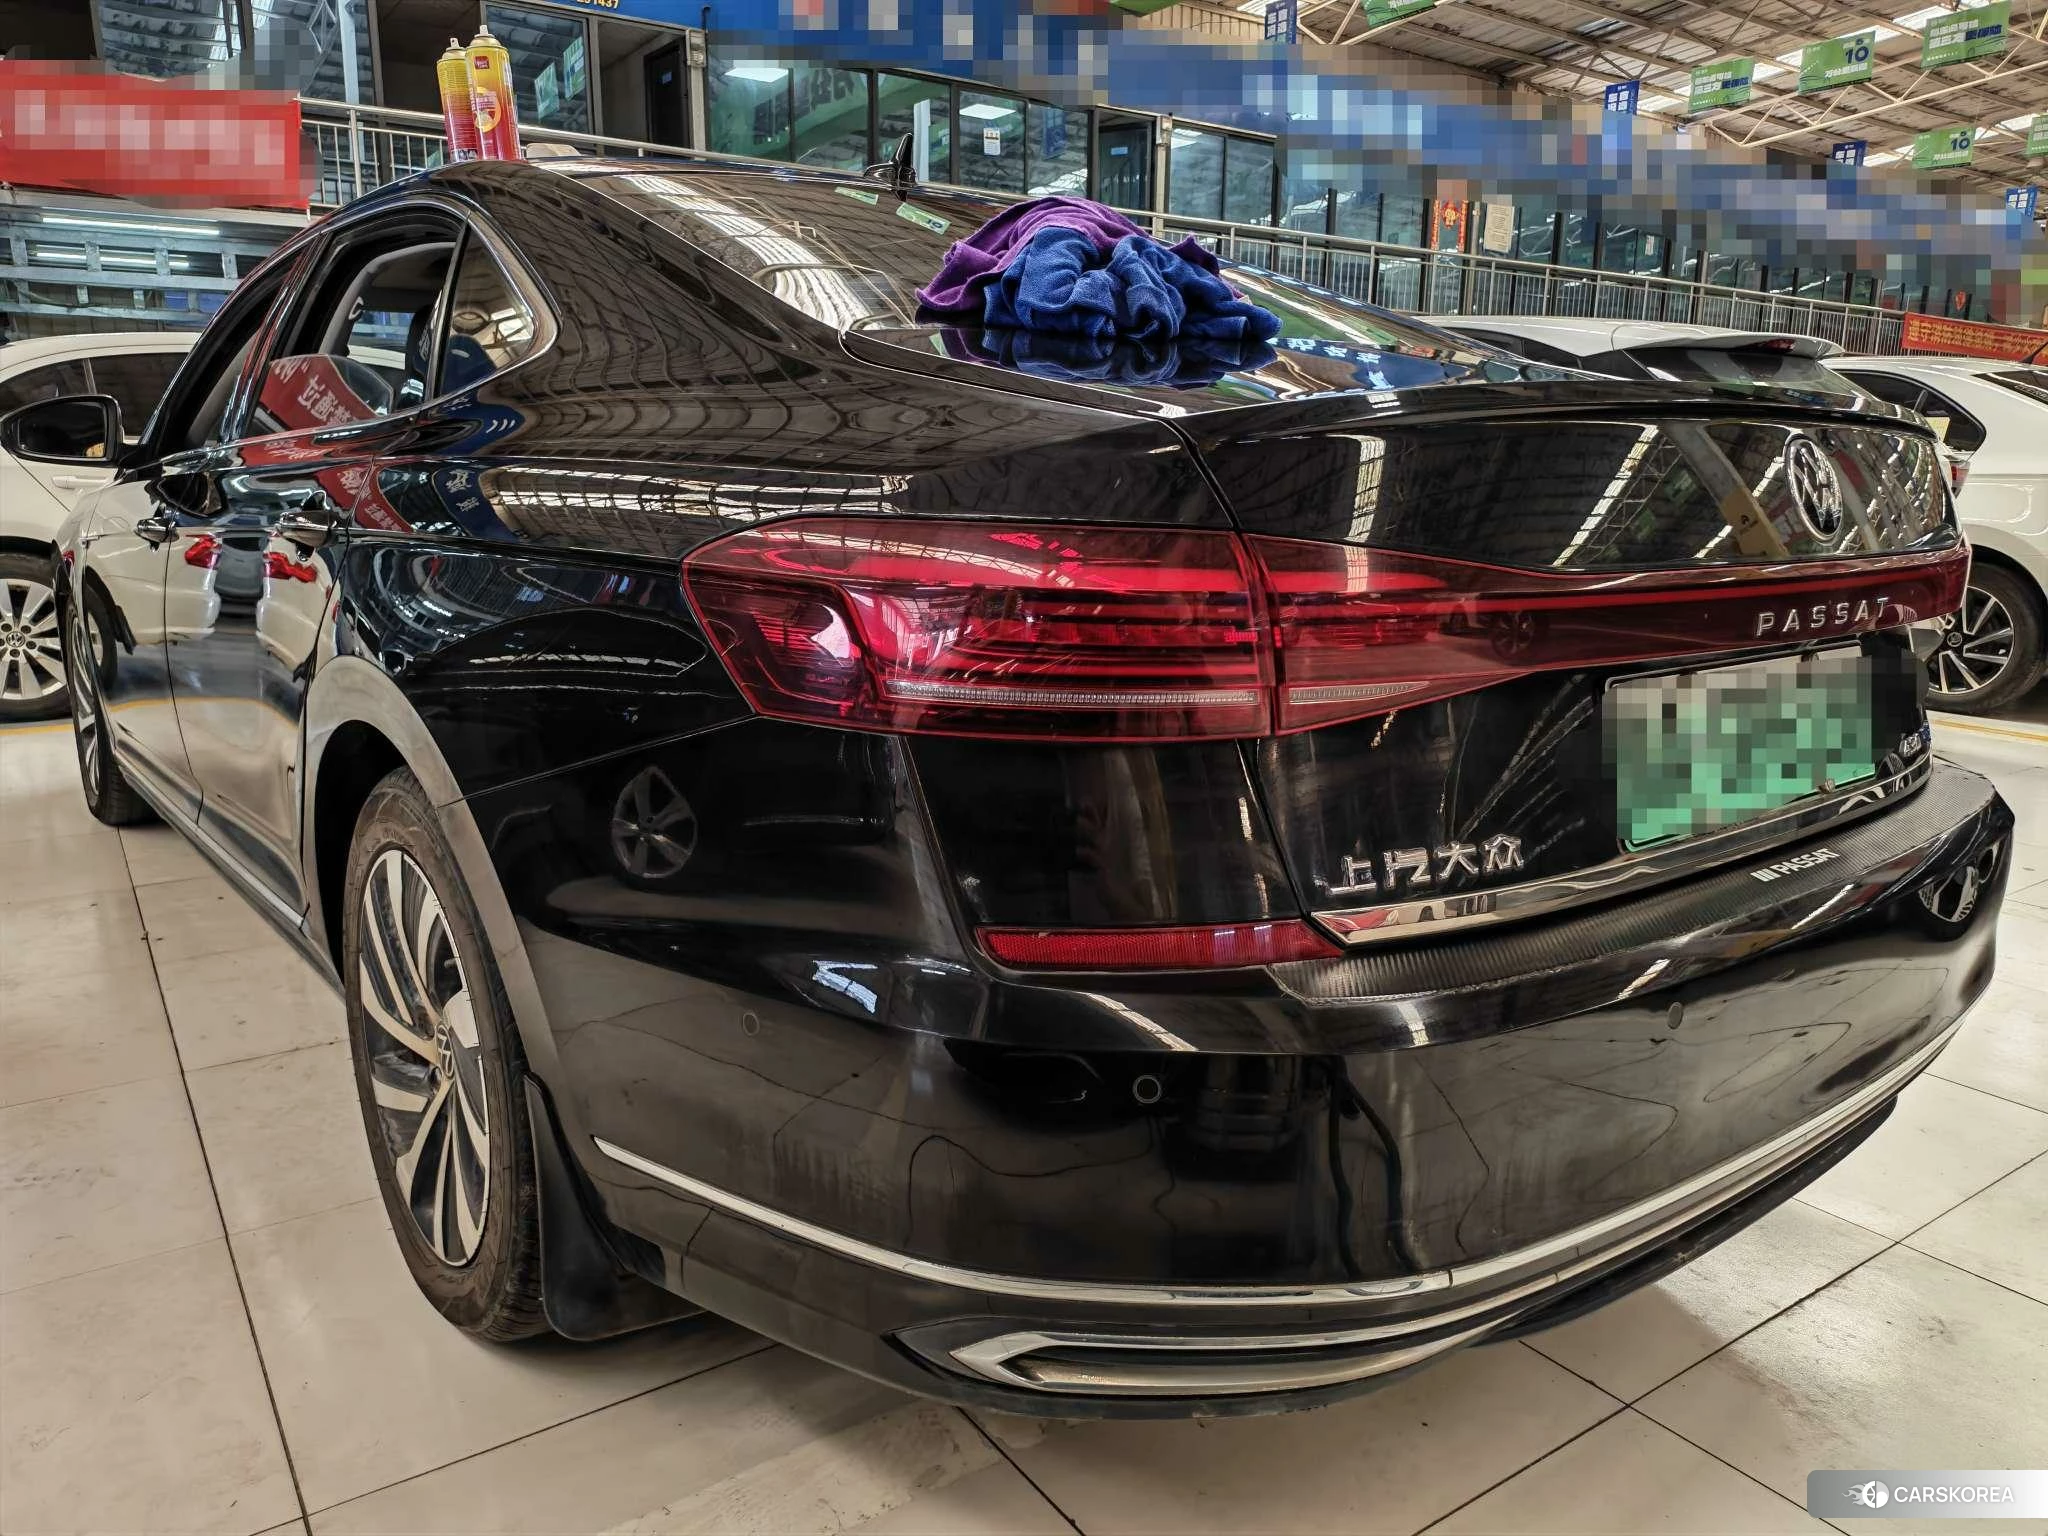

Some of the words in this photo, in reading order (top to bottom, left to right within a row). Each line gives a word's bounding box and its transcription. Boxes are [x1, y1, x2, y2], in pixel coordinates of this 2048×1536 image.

[1845, 46, 1869, 64] 10
[1951, 138, 1971, 151] 10
[1756, 597, 1889, 637] PASSAT
[1316, 834, 1524, 896] 上汽大众
[1770, 848, 1840, 875] PASSAT
